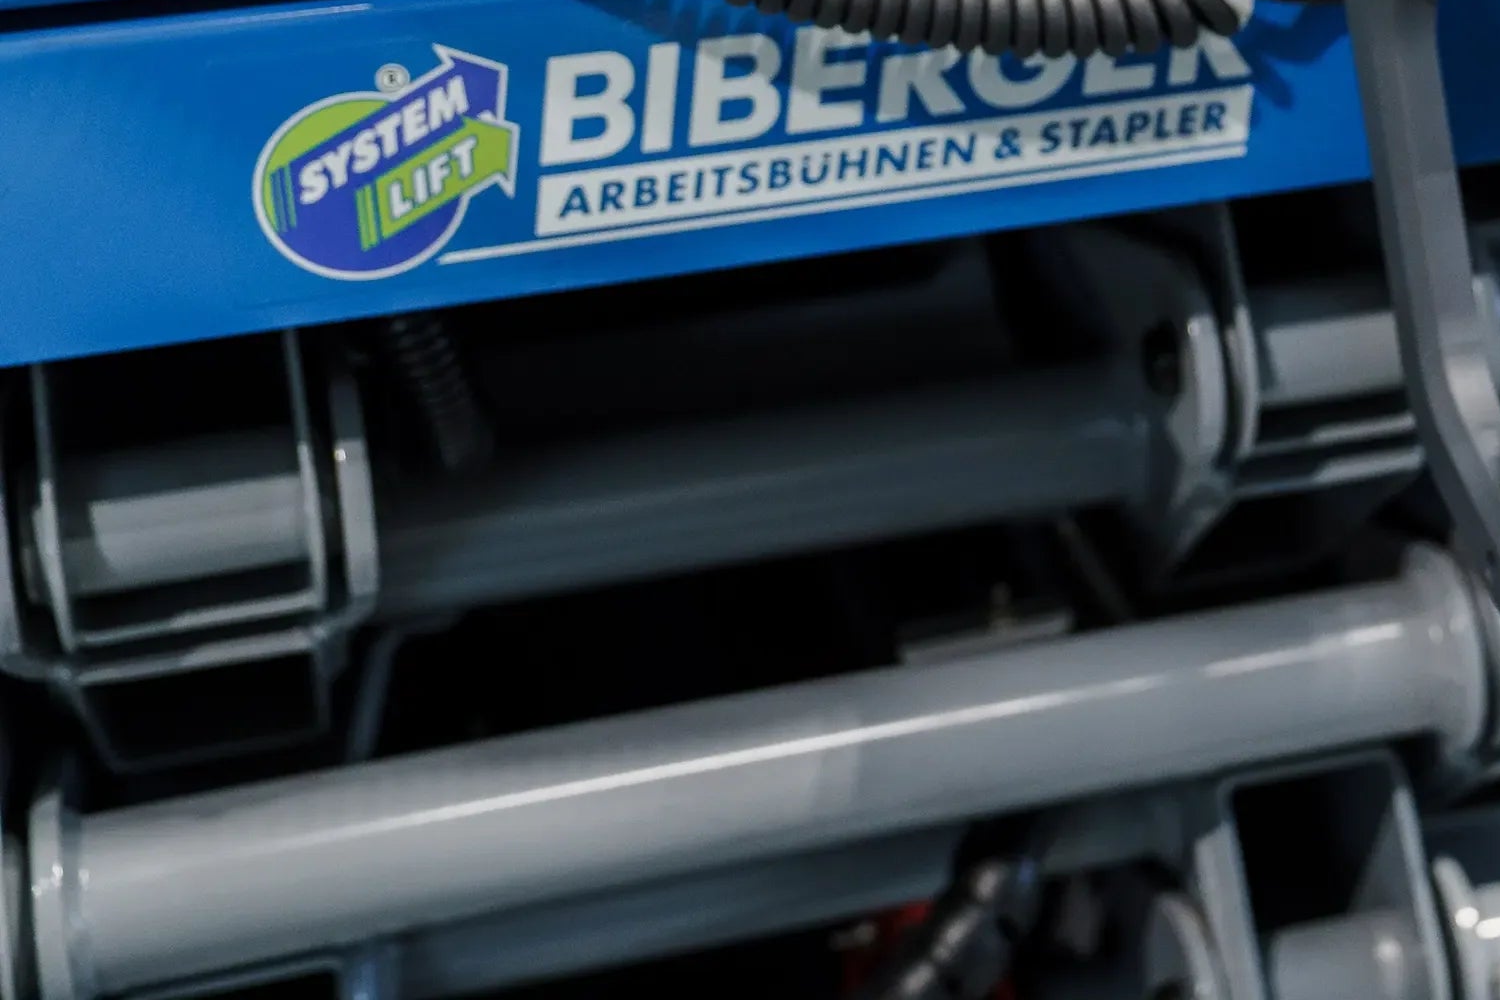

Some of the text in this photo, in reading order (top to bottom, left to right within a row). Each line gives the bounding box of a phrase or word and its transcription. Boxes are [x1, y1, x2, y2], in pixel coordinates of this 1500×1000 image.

[299, 74, 469, 205] SYSTEM
[388, 134, 477, 219] LIFT
[559, 101, 1227, 219] ARBEITSBÜHNEN & STAPLER
